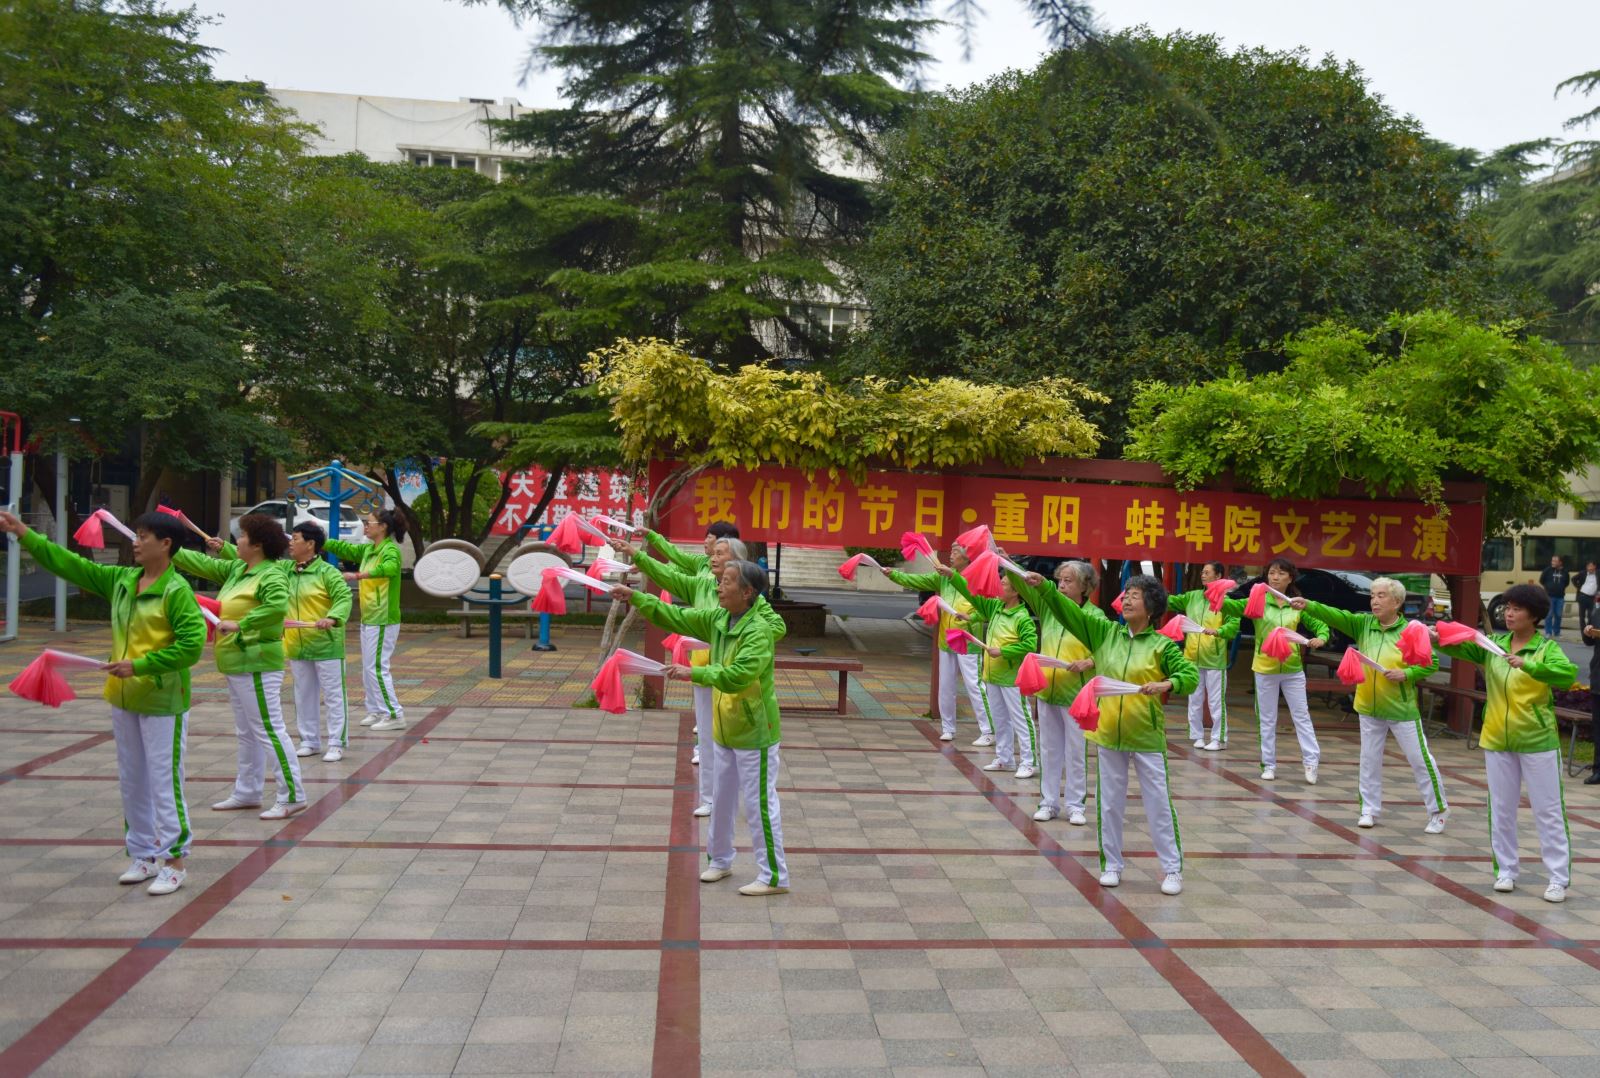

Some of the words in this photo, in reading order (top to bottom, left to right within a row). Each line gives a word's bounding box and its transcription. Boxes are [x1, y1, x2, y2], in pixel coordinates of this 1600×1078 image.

[1124, 498, 1449, 562] 蚌埠院文艺汇演
